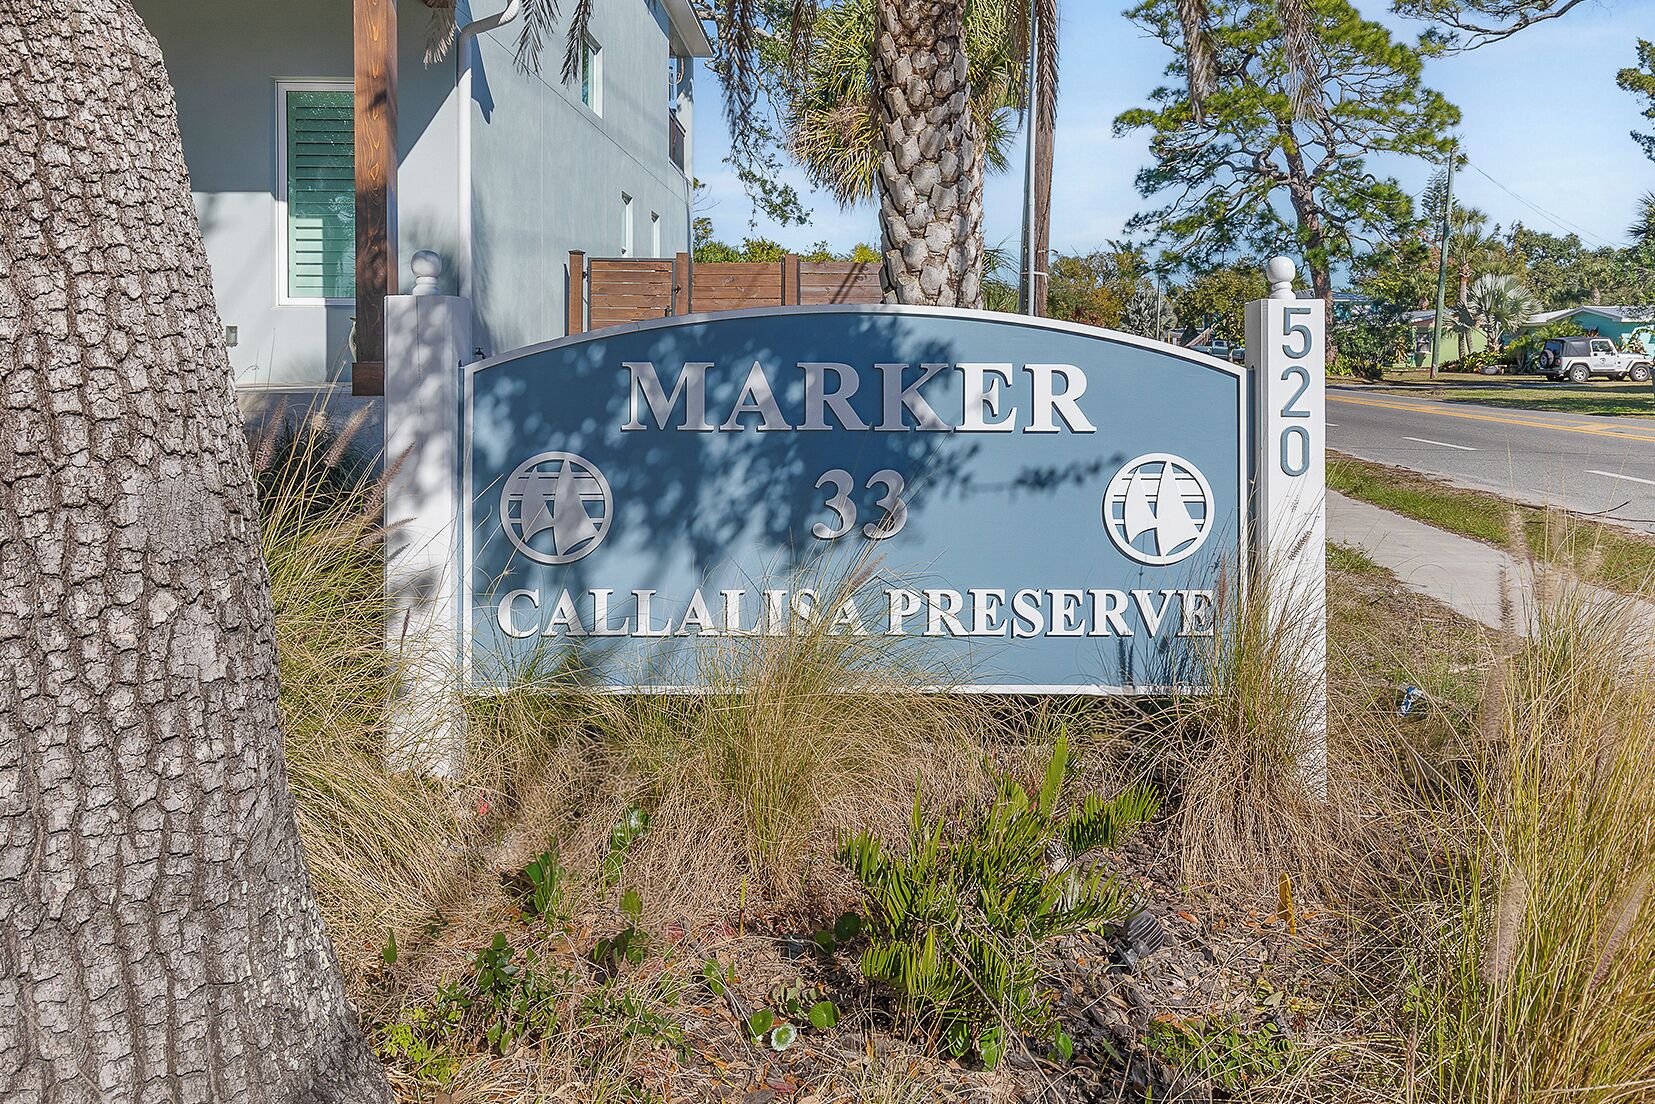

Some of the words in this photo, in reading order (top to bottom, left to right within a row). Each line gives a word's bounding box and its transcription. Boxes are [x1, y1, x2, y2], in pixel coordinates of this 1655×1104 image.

[620, 360, 1098, 434] MARKER
[1280, 306, 1313, 477] 520
[811, 468, 909, 541] 33
[884, 587, 1216, 639] PRESERVE
